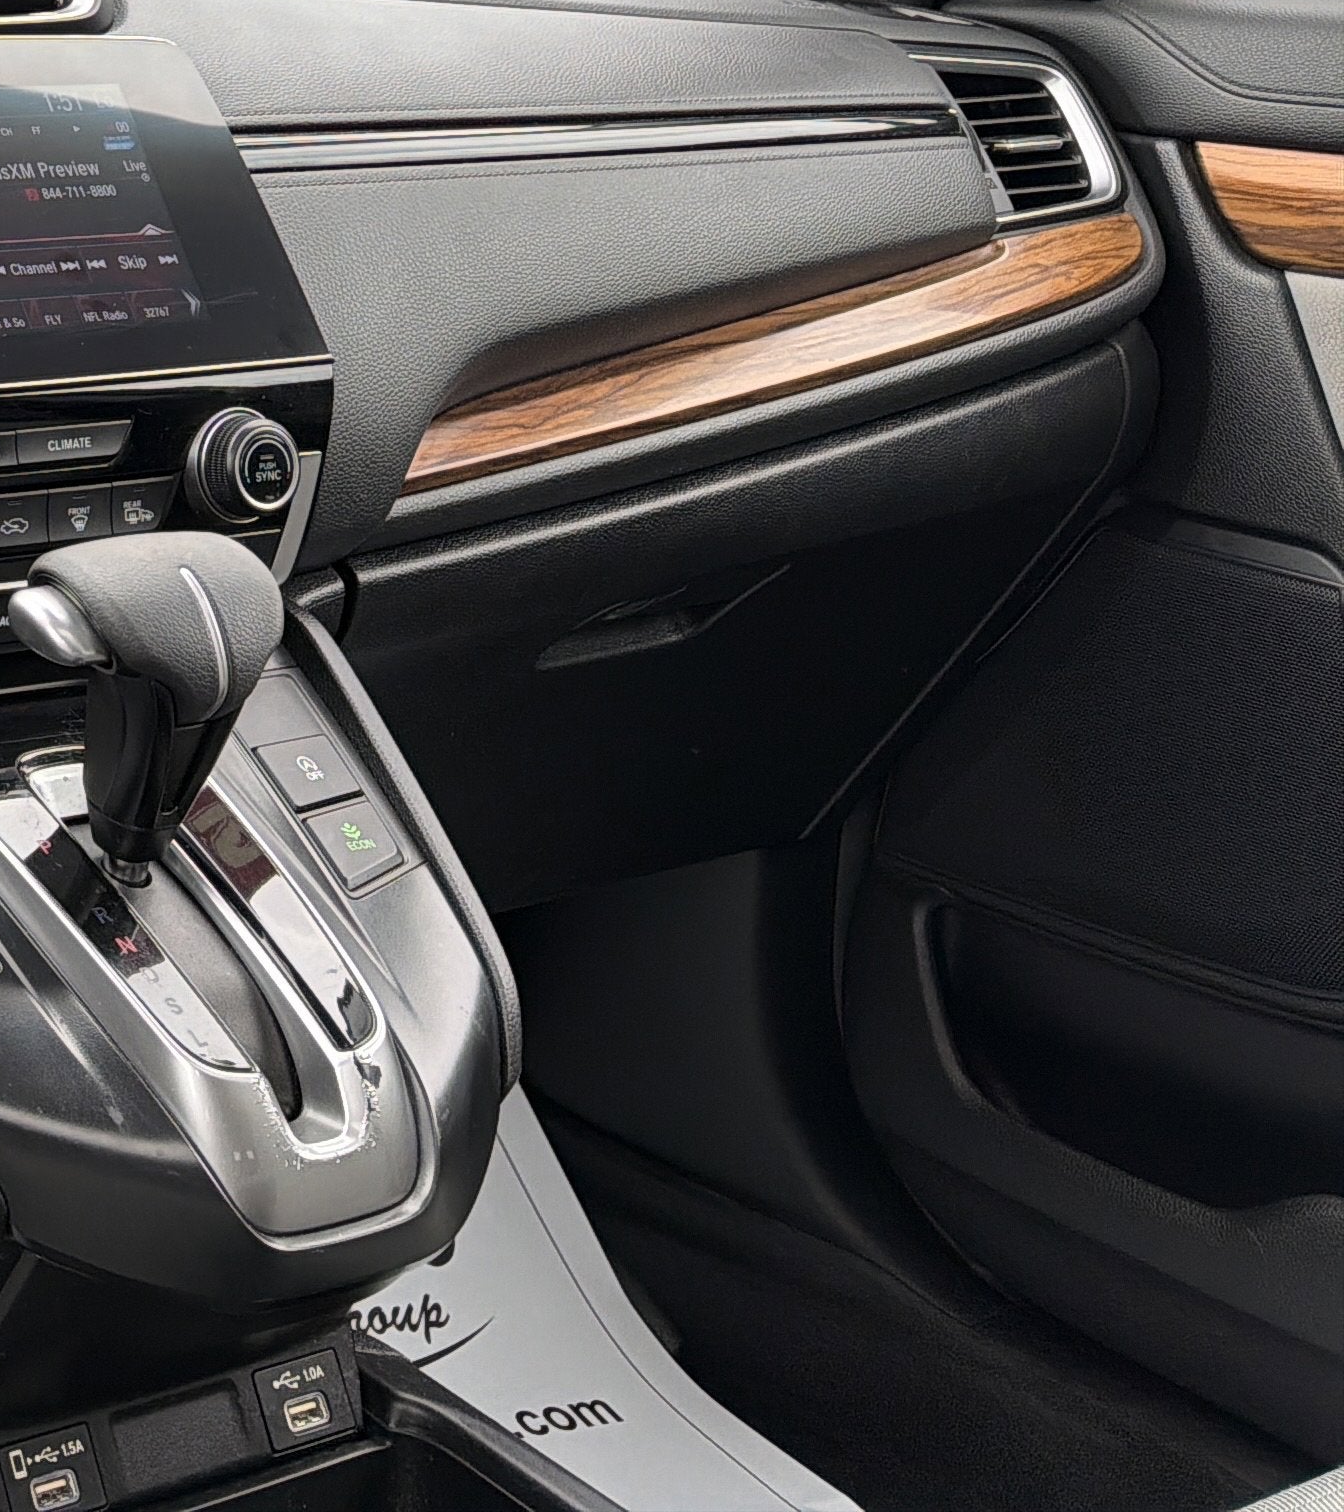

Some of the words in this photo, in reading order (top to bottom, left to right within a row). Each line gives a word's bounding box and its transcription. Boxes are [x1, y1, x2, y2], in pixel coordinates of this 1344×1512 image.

[37, 160, 100, 180] Preview
[123, 159, 147, 172] Live
[41, 184, 117, 201] 844-711-8800
[10, 261, 58, 277] Channel
[118, 255, 148, 271] Skip
[44, 314, 62, 326] FLY
[82, 311, 102, 323] NFL
[103, 309, 129, 322] Radio
[47, 437, 92, 452] CLIMATE
[258, 461, 277, 470] PUSH
[255, 469, 282, 483] SYNC
[67, 505, 91, 516] FRONT
[123, 500, 142, 509] REAR
[37, 839, 52, 855] P
[346, 838, 376, 852] ECON
[91, 906, 115, 925] R
[115, 935, 138, 955] N
[164, 997, 184, 1015] S
[303, 1365, 325, 1383] 1.0A
[513, 1399, 624, 1439] .com
[61, 1438, 85, 1457] 1.5A
